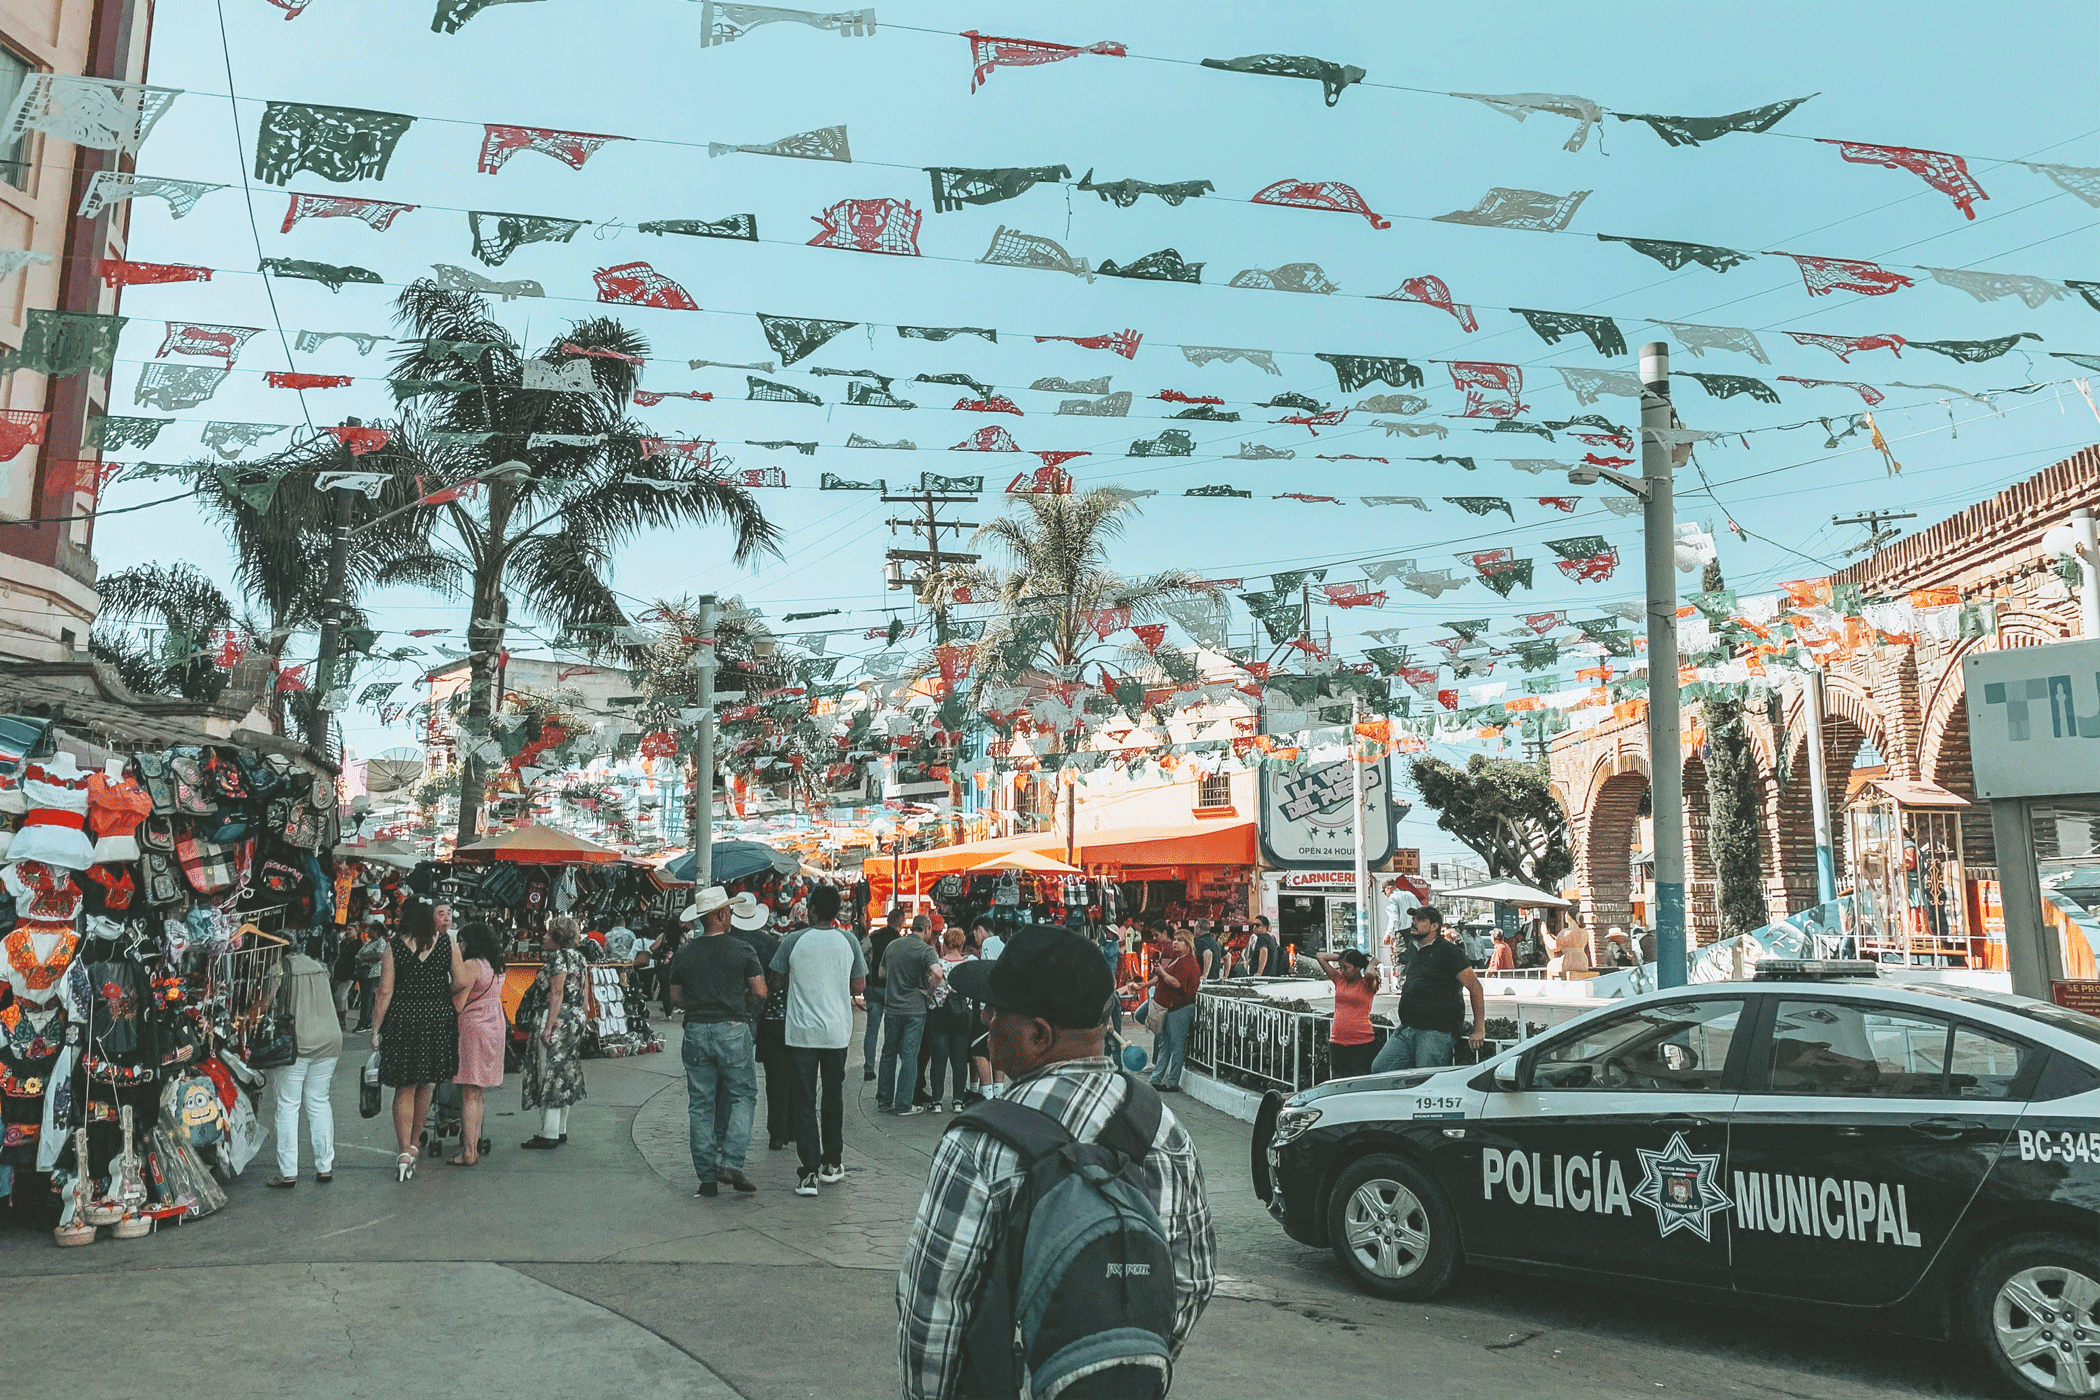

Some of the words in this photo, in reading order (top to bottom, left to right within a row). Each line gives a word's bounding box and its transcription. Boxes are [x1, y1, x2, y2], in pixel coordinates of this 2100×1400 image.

[1291, 777, 1321, 800] LA
[1285, 796, 1320, 820] DEL
[2066, 984, 2079, 992] SE
[1416, 1097, 1463, 1109] 19-157
[1483, 1147, 1632, 1217] POLICÍA
[1734, 1171, 1921, 1247] MUNICIPAL
[1665, 1202, 1688, 1210] TIJUANA
